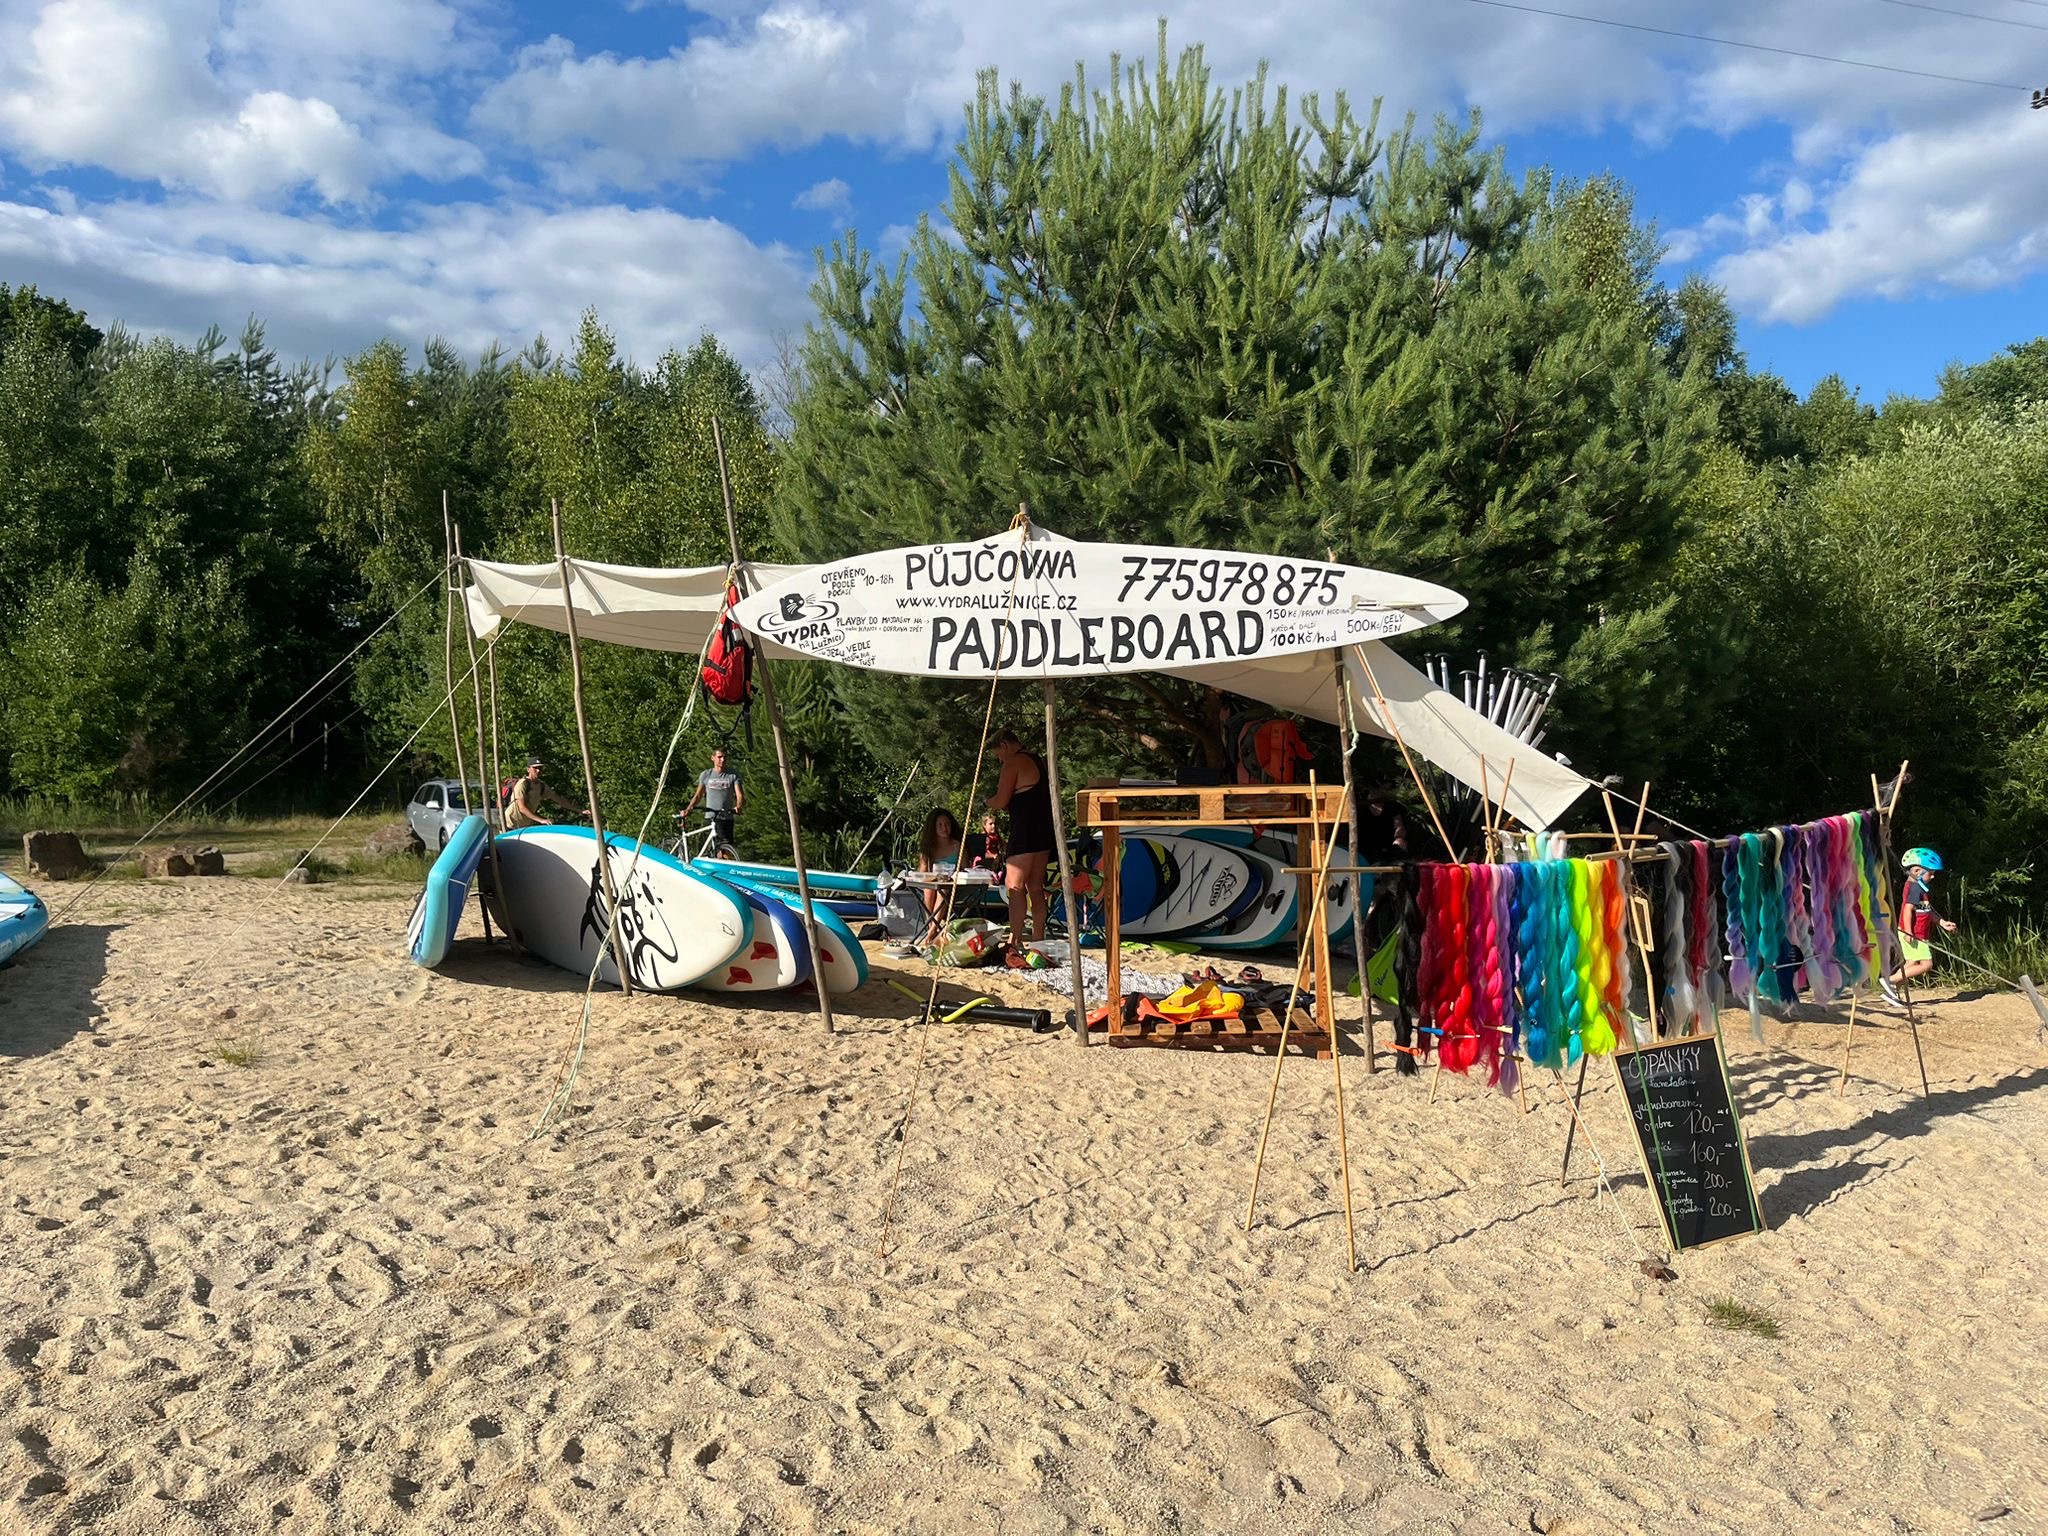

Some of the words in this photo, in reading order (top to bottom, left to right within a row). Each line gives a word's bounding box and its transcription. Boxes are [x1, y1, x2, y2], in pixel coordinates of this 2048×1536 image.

[821, 566, 866, 584] OTEVŘENO
[905, 543, 1077, 590] PŮJČOVNA
[831, 579, 856, 590] PODLE
[863, 574, 894, 586] 10-18h
[1117, 557, 1346, 607] 775978875
[836, 615, 866, 627] PLAVBY
[868, 615, 879, 625] DO
[1383, 623, 1402, 634] DEN
[772, 623, 831, 645] VYDRA
[928, 605, 1264, 671] PADDLEBOARD
[845, 640, 871, 653] VEDLE
[1628, 1047, 1701, 1079] COPÁNKY
